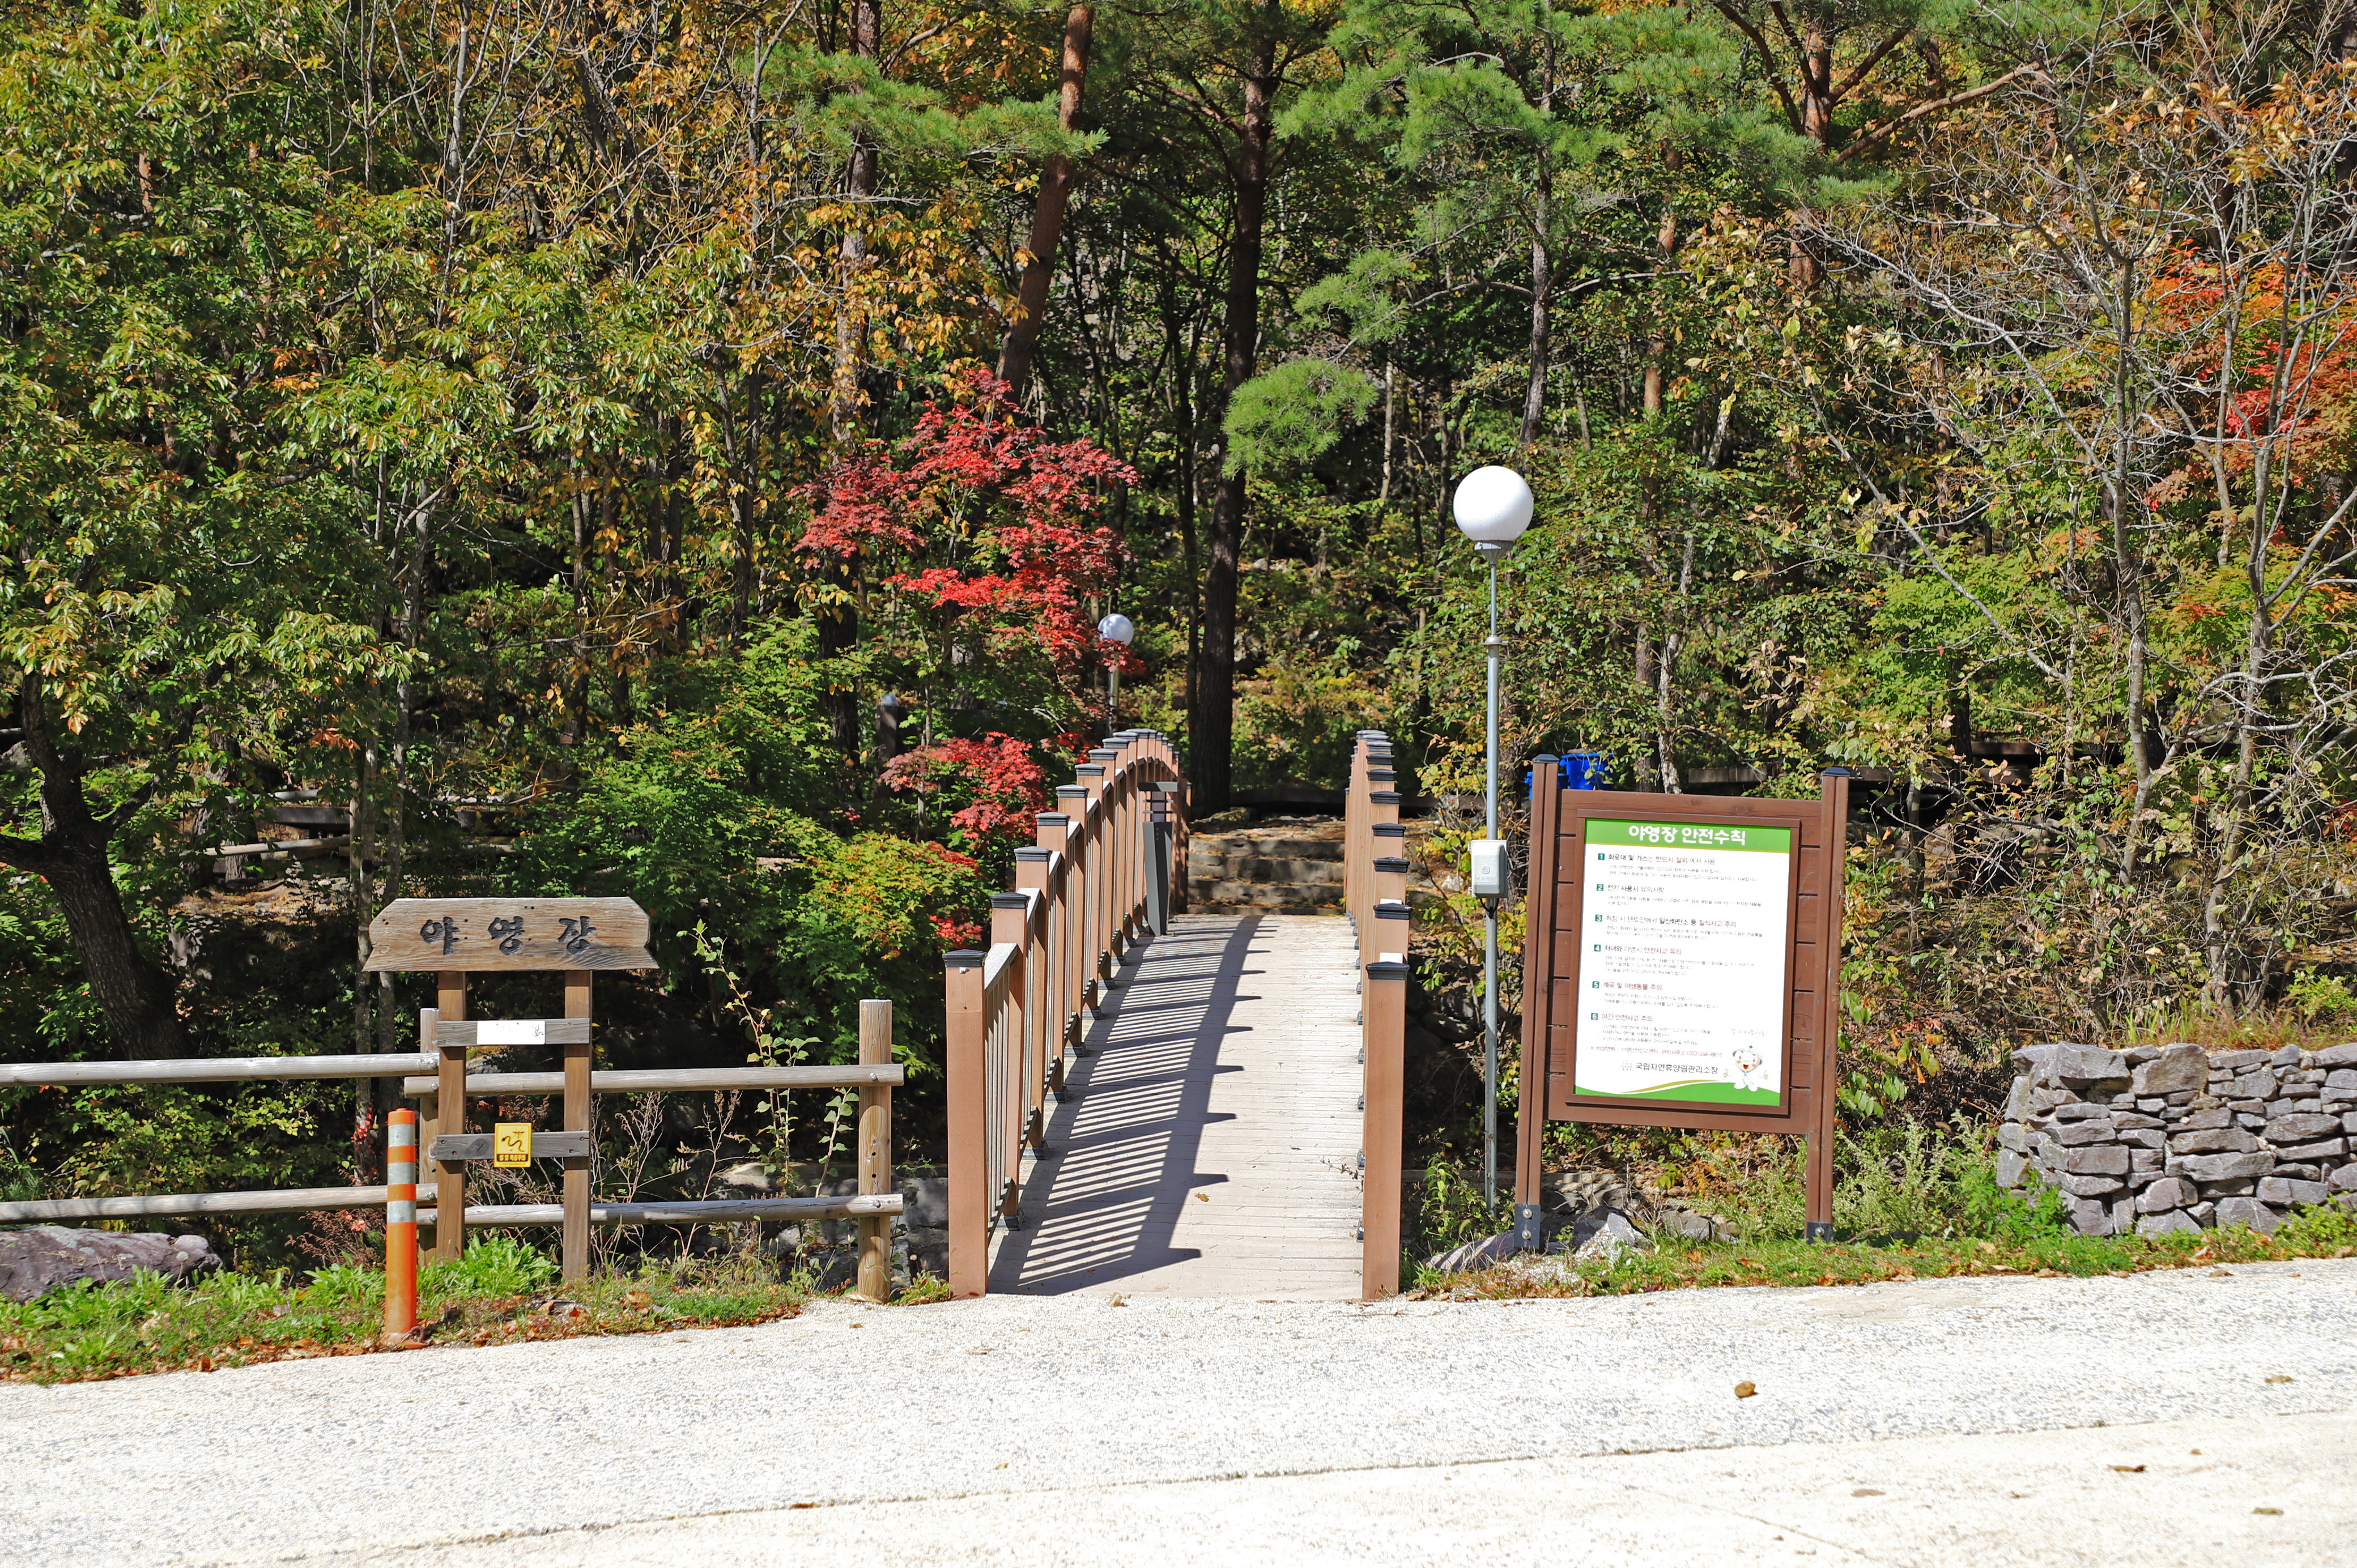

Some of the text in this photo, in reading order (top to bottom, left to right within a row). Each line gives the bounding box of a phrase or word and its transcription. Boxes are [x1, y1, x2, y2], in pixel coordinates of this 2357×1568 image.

[1628, 824, 1746, 846] 야영장 안전수칙
[1608, 853, 1626, 861] 화로대
[1640, 885, 1664, 894] 유의사항
[1605, 914, 1618, 922] 취침
[1627, 915, 1657, 924] 텐트안에서
[1658, 917, 1688, 926] 일산화탄소
[1699, 919, 1722, 928] 질식사고
[1724, 920, 1737, 928] 주의
[420, 916, 595, 955] 야영장
[1623, 945, 1642, 953] 야영시
[1643, 946, 1667, 955] 안전사고
[1635, 1062, 1718, 1075] 국립자연휴양림관리소장
